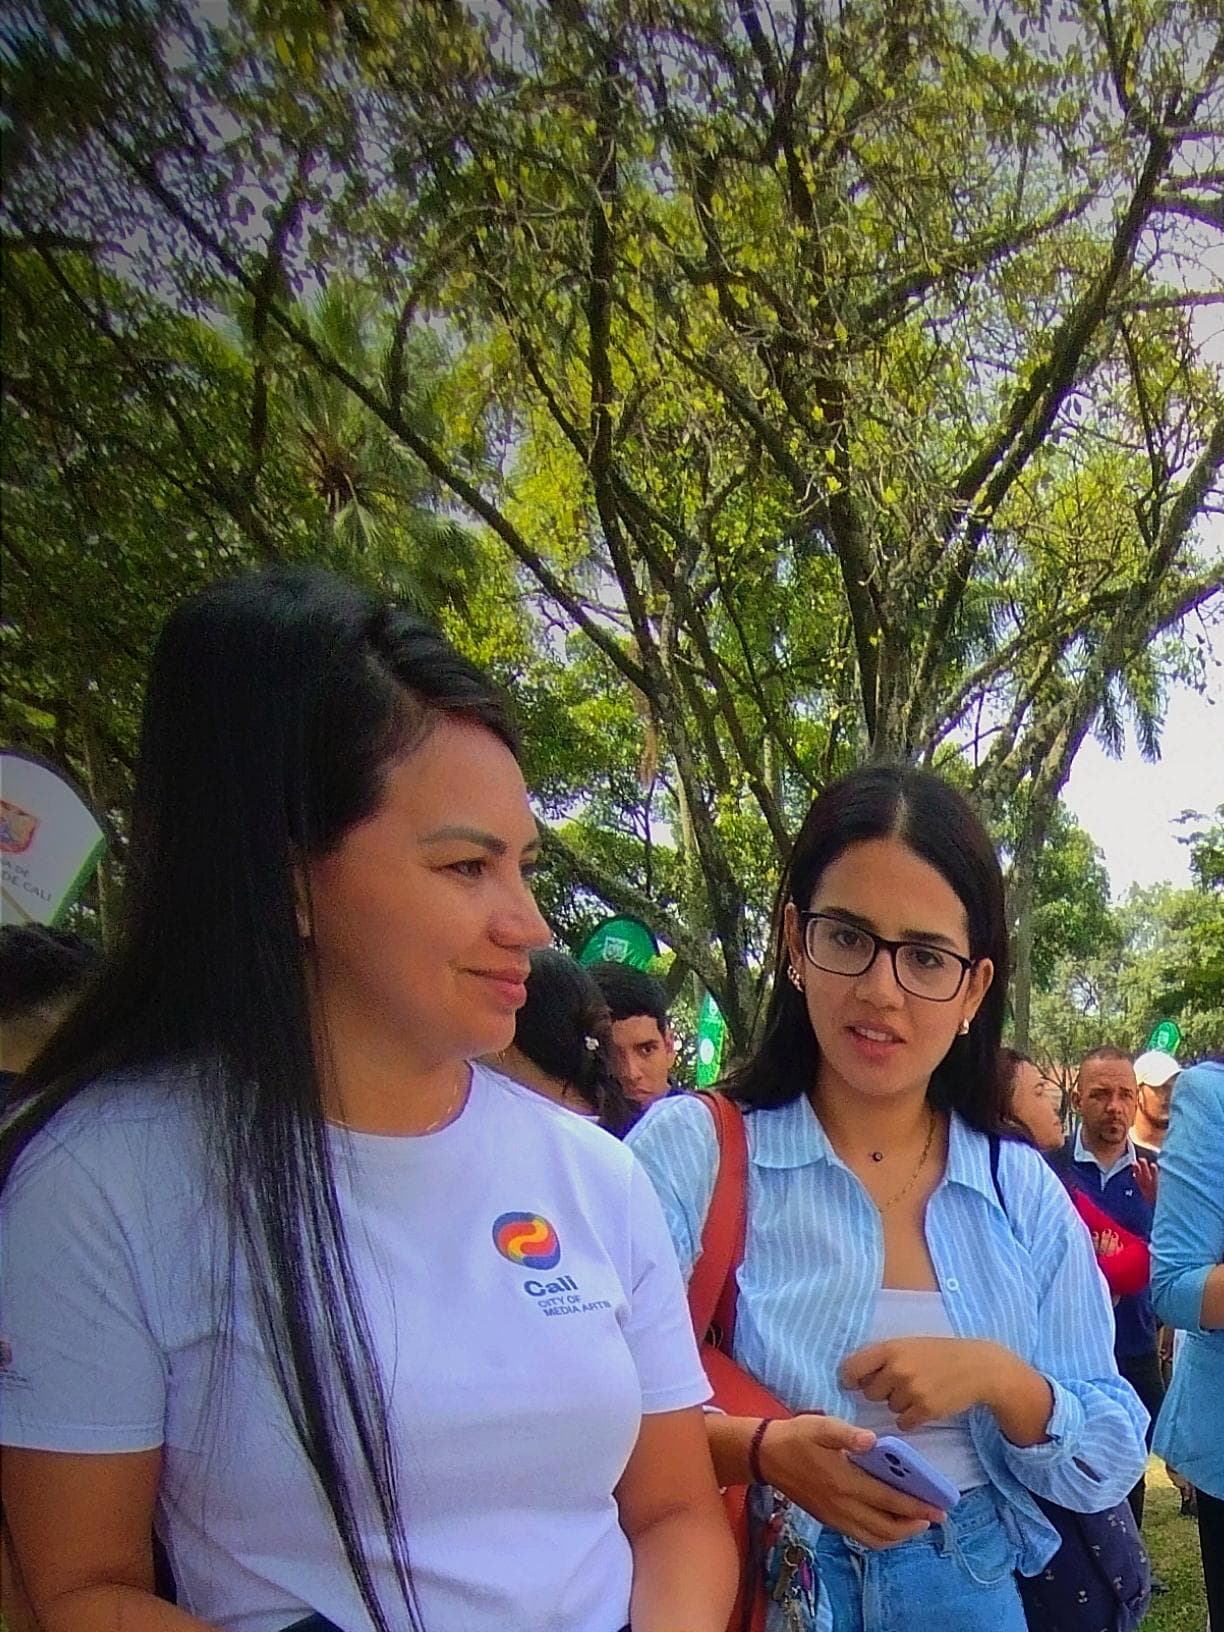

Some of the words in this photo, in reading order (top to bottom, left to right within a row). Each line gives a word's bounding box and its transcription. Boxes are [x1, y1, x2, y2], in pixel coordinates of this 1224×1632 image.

[523, 1275, 578, 1297] Cali
[567, 1294, 581, 1304] OF
[543, 1305, 581, 1317] MEDIA
